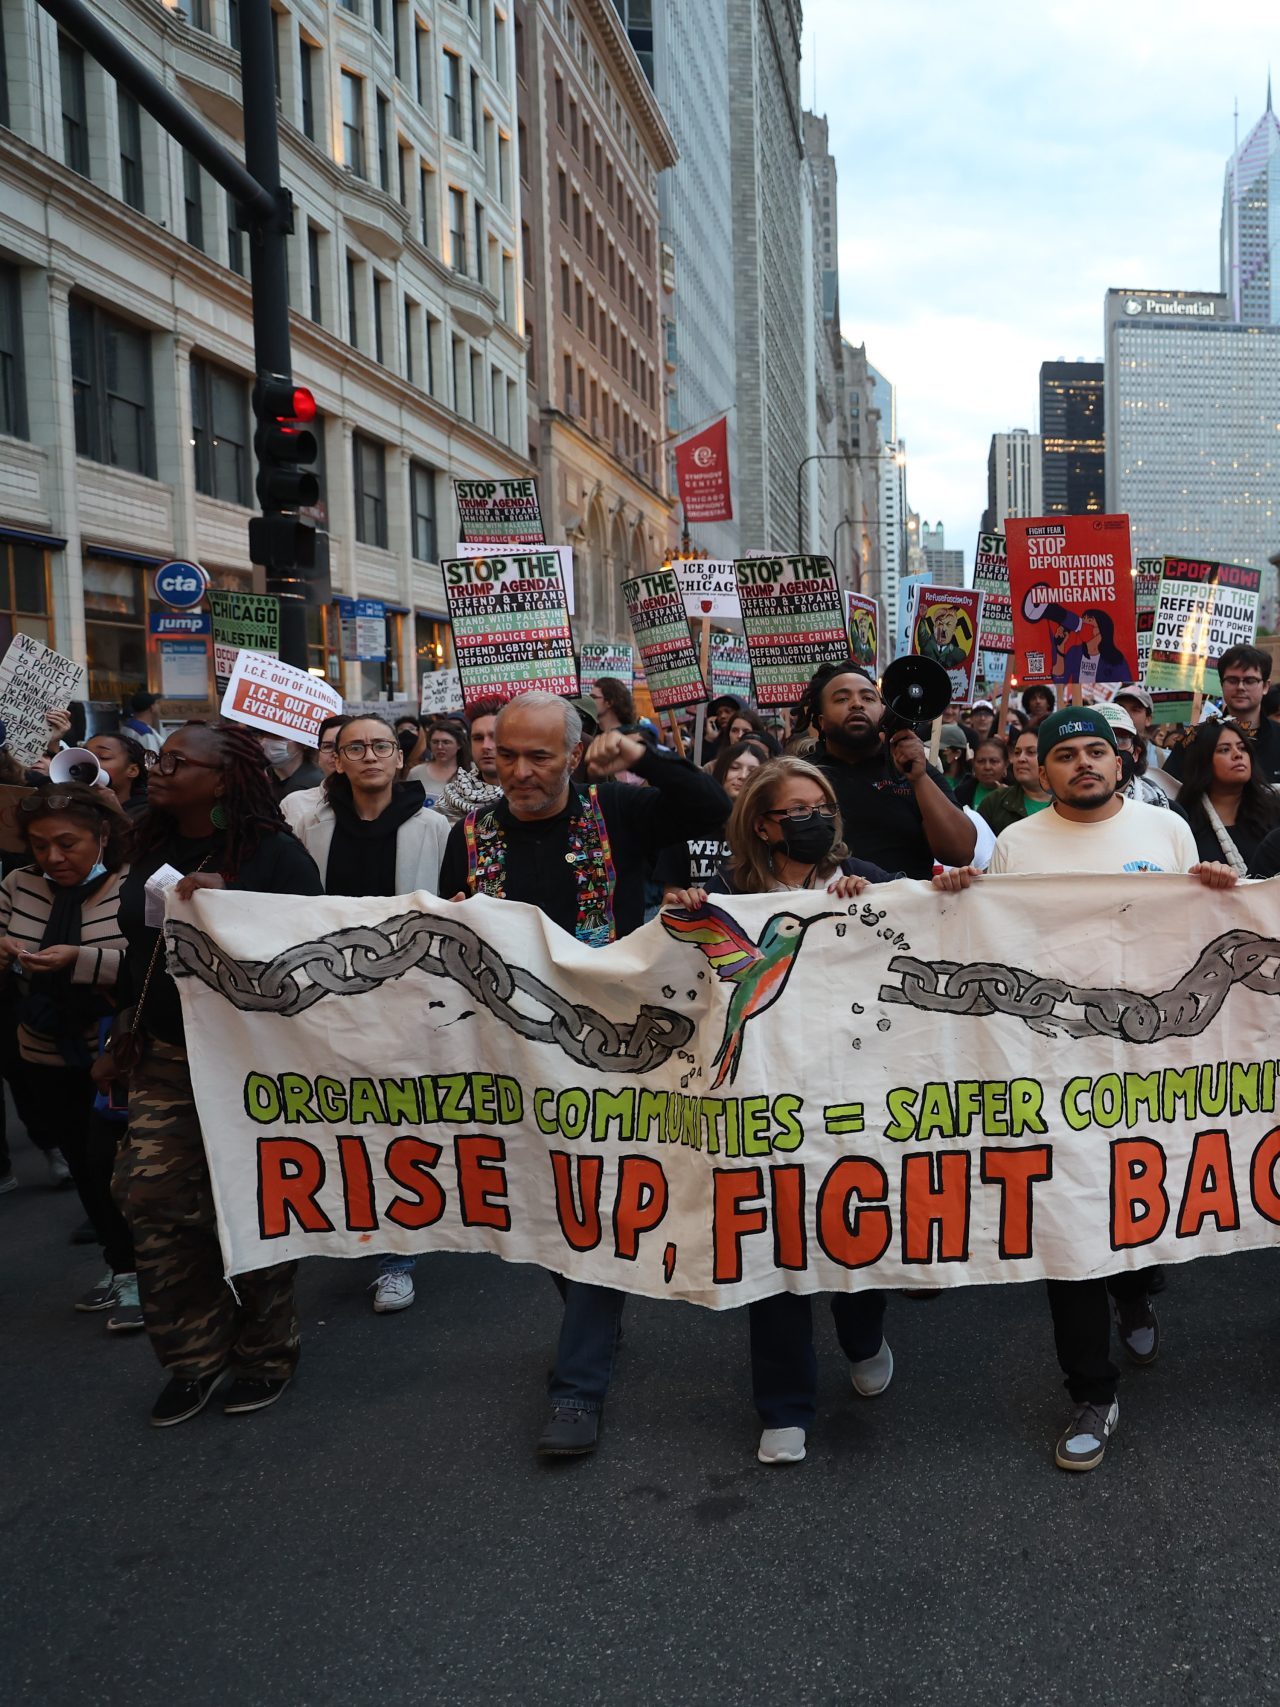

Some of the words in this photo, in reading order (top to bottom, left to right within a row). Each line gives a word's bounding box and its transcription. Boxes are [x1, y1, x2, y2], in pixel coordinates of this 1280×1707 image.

[1146, 300, 1214, 316] Prudential
[685, 478, 723, 487] CENTER
[686, 494, 724, 502] CHICAGO
[1028, 537, 1066, 555] STOP
[446, 558, 508, 585] STOP
[511, 554, 556, 579] THE
[684, 564, 704, 573] ICE
[708, 564, 734, 574] OUT
[735, 559, 785, 585] STOP
[785, 557, 831, 581] THE
[1029, 554, 1114, 569] DEPORTATIONS
[162, 575, 197, 591] cta
[1059, 569, 1115, 587] DEFEND
[1165, 561, 1211, 580] CPOP
[1217, 566, 1259, 589] NOW!
[448, 583, 494, 598] TRUMP
[498, 577, 560, 593] AGENDA!
[739, 583, 775, 597] TRUMP
[777, 579, 834, 594] AGENDA!
[1032, 586, 1116, 603] IMMIGRANTS
[1162, 583, 1225, 600] SUPPORT
[1231, 591, 1255, 607] THE
[213, 601, 277, 624] CHICAGO
[1160, 597, 1254, 623] REFERENDUM
[157, 619, 203, 632] jump
[267, 626, 277, 635] TO
[1227, 621, 1253, 633] POWER
[214, 628, 277, 649] PALESTINE
[19, 636, 37, 655] We
[40, 648, 84, 679] MARCH
[19, 654, 29, 665] to
[11, 675, 41, 697] HUMAN
[15, 665, 61, 695] CIVILITY
[244, 664, 268, 680] I.C.E.
[271, 673, 291, 687] OUT
[292, 681, 303, 691] OF
[305, 686, 337, 709] ILLINOIS
[0, 694, 45, 723] AMERICA
[248, 684, 279, 706] I.C.E.
[283, 697, 311, 715] OUT
[312, 707, 329, 722] OF
[19, 714, 47, 736] Values
[244, 1070, 524, 1127] ORGANIZED
[533, 1086, 804, 1157] COMMUNITIES
[884, 1076, 1049, 1144] SAFER
[256, 1134, 512, 1240] RISE
[551, 1150, 678, 1283] UP,
[712, 1143, 1053, 1285] FIGHT
